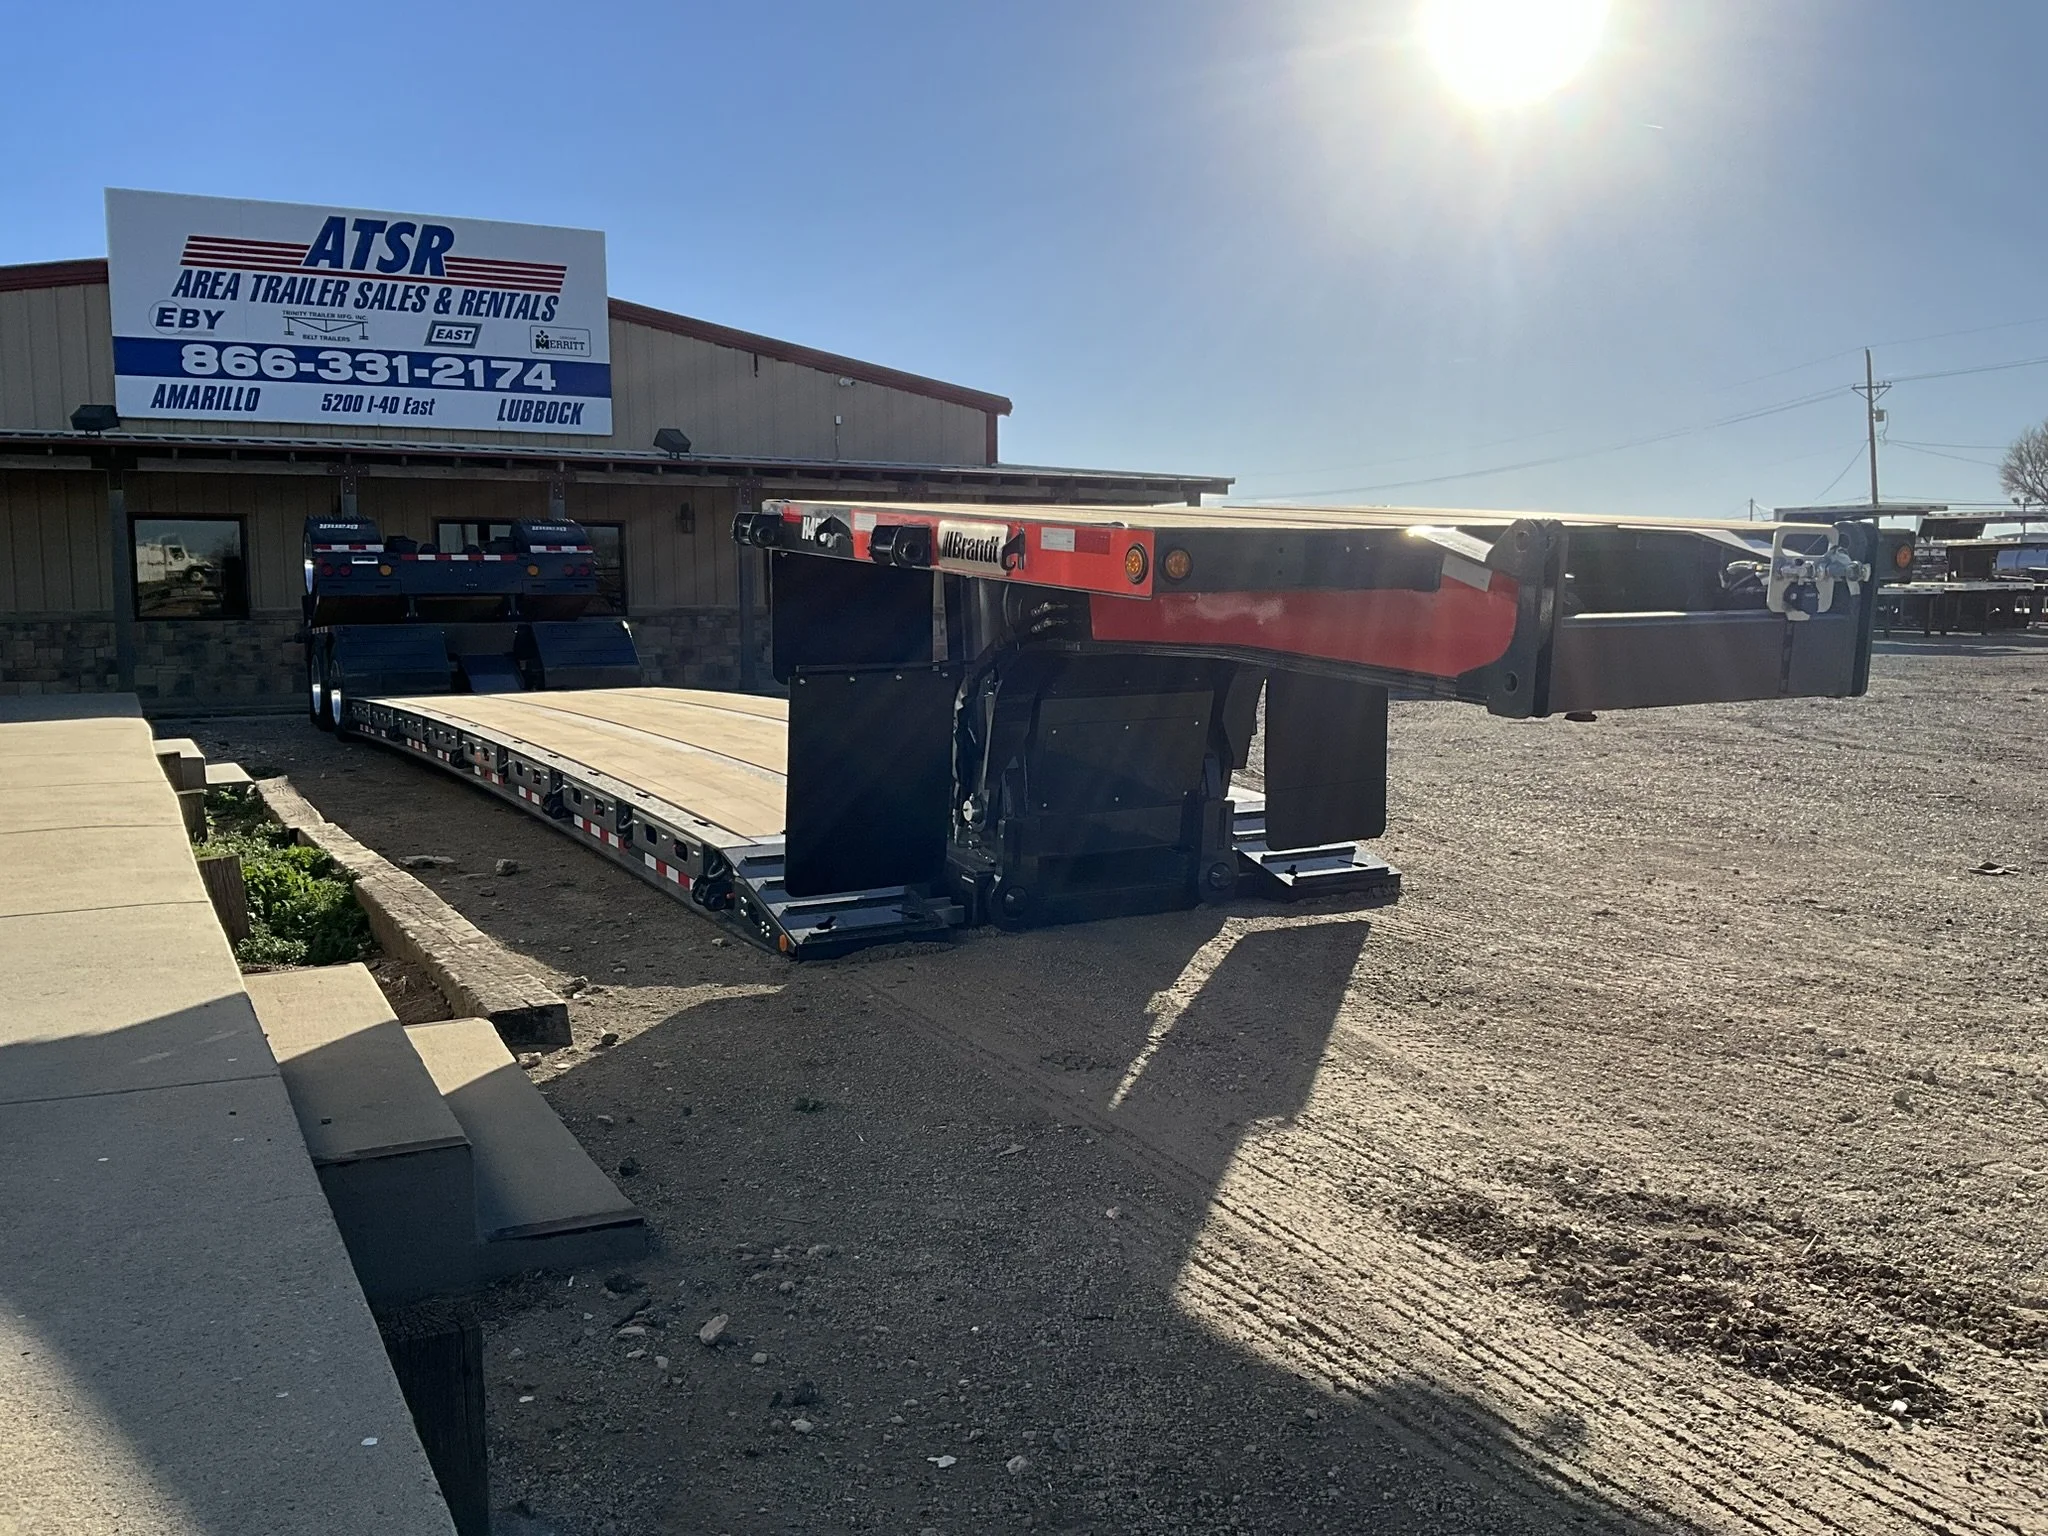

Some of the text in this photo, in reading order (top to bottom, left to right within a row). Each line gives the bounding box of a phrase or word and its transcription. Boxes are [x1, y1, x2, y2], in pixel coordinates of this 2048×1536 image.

[301, 215, 454, 276] ATSR
[172, 270, 560, 322] AREA TRAILER SALES & RENTALS
[155, 307, 224, 331] EBY
[434, 327, 473, 343] EAST
[535, 338, 585, 351] MERRITT
[181, 344, 557, 392] 866-331-2174
[150, 383, 261, 413] AMARILLO
[321, 393, 436, 416] 5200 I-40 East
[496, 398, 585, 426] LUBBOCK
